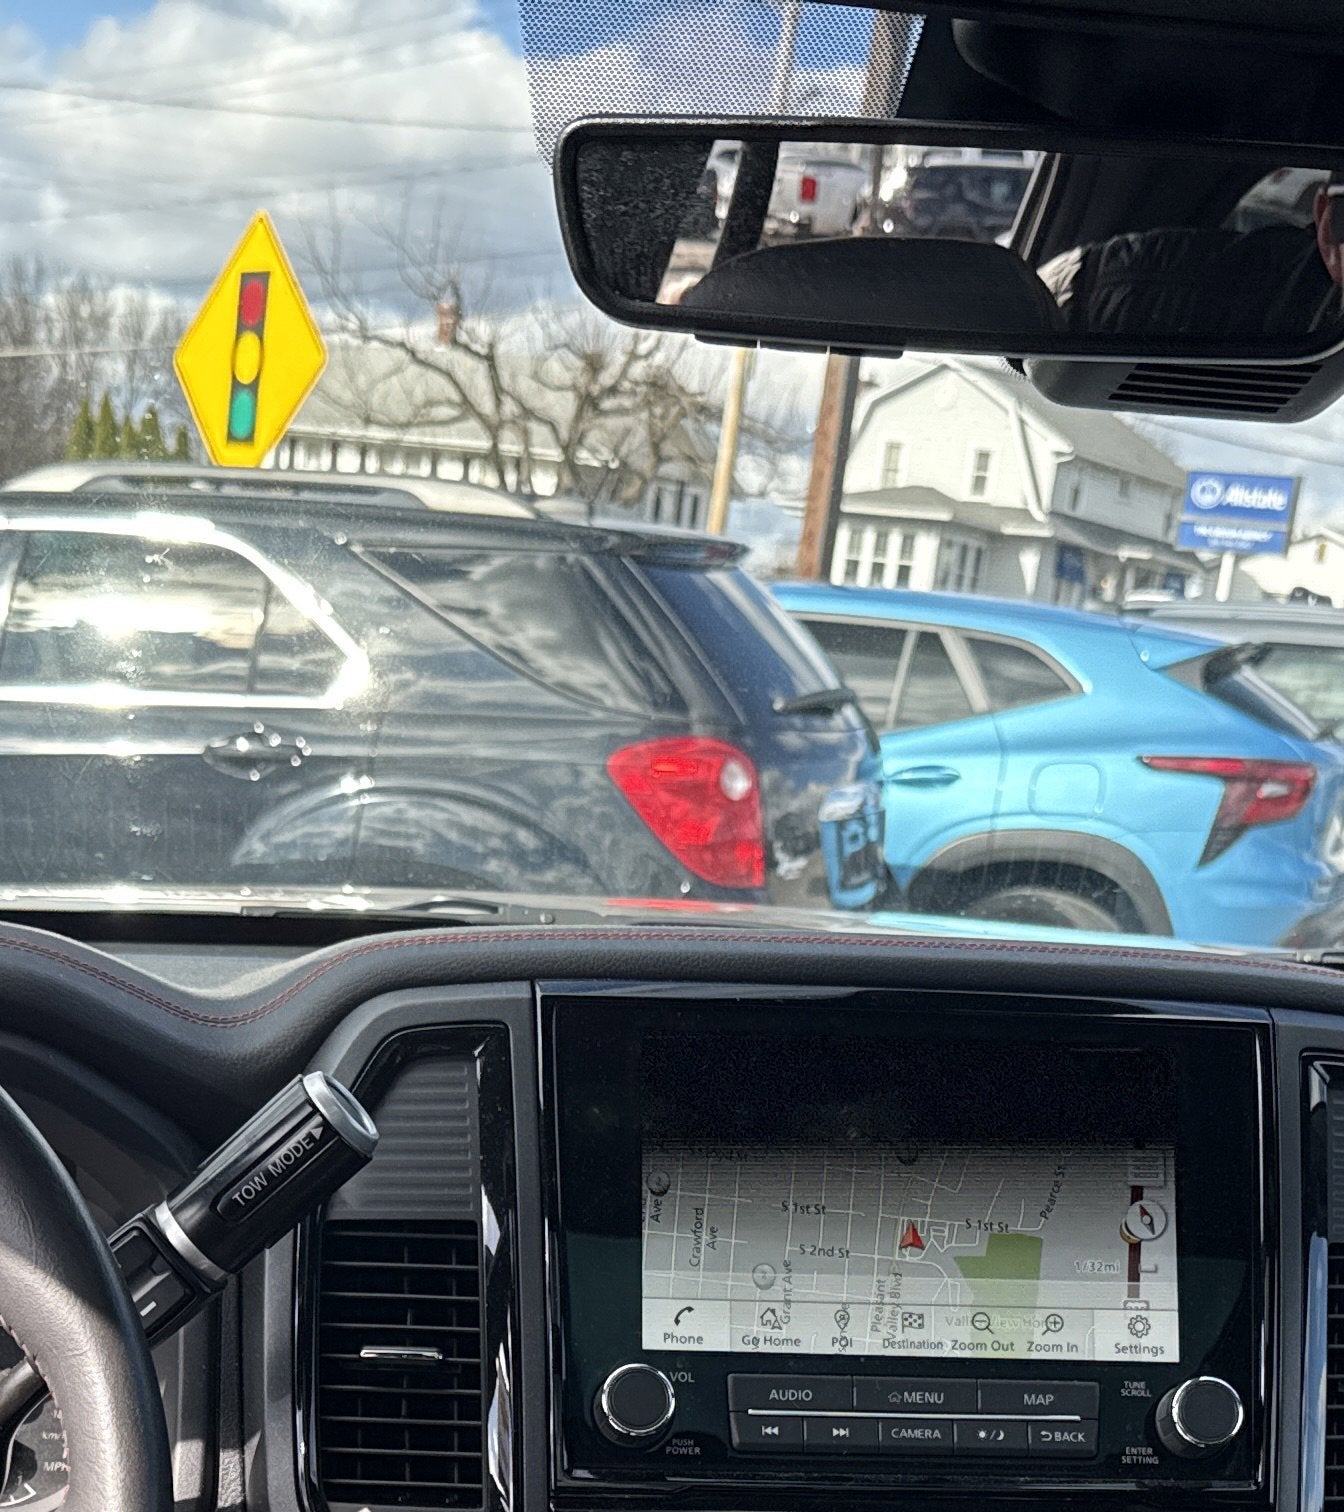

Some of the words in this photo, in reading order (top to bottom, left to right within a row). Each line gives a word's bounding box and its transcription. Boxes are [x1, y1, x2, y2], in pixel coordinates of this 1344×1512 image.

[231, 1171, 268, 1206] TOW
[267, 1135, 315, 1177] MODE
[649, 1199, 663, 1223] Ave
[793, 1202, 811, 1215] 1st
[814, 1203, 827, 1215] St
[977, 1220, 994, 1231] 1st
[997, 1221, 1010, 1233] St
[689, 1207, 705, 1267] Crawford
[706, 1225, 719, 1251] Ave
[808, 1244, 835, 1257] 2nd
[838, 1248, 850, 1259] St
[781, 1259, 793, 1286] Ave
[889, 1272, 903, 1299] Blvd
[779, 1288, 793, 1325] Grant
[870, 1279, 887, 1333] Pleasant
[885, 1303, 902, 1341] Valley
[663, 1332, 704, 1345] Phone
[741, 1334, 760, 1347] Go
[763, 1335, 802, 1347] Home
[831, 1336, 853, 1347] POI
[882, 1338, 944, 1350] Destination
[951, 1340, 988, 1351] Zoom
[991, 1340, 1015, 1351] Out
[1026, 1341, 1063, 1352] Zoom
[1066, 1342, 1079, 1353] In
[1114, 1342, 1165, 1357] Settings
[670, 1372, 695, 1383] VOL
[1124, 1381, 1146, 1389] TUNE
[769, 1389, 813, 1401] AUDIO
[903, 1391, 945, 1404] MENU
[1023, 1393, 1055, 1405] MAP
[1121, 1388, 1152, 1398] SCROLL
[891, 1428, 942, 1439] CAMERA
[1054, 1431, 1086, 1443] BACK
[672, 1438, 695, 1446] PUSH
[665, 1446, 701, 1455] POWER
[1125, 1447, 1154, 1455] ENTER
[1121, 1456, 1159, 1465] SETTING
